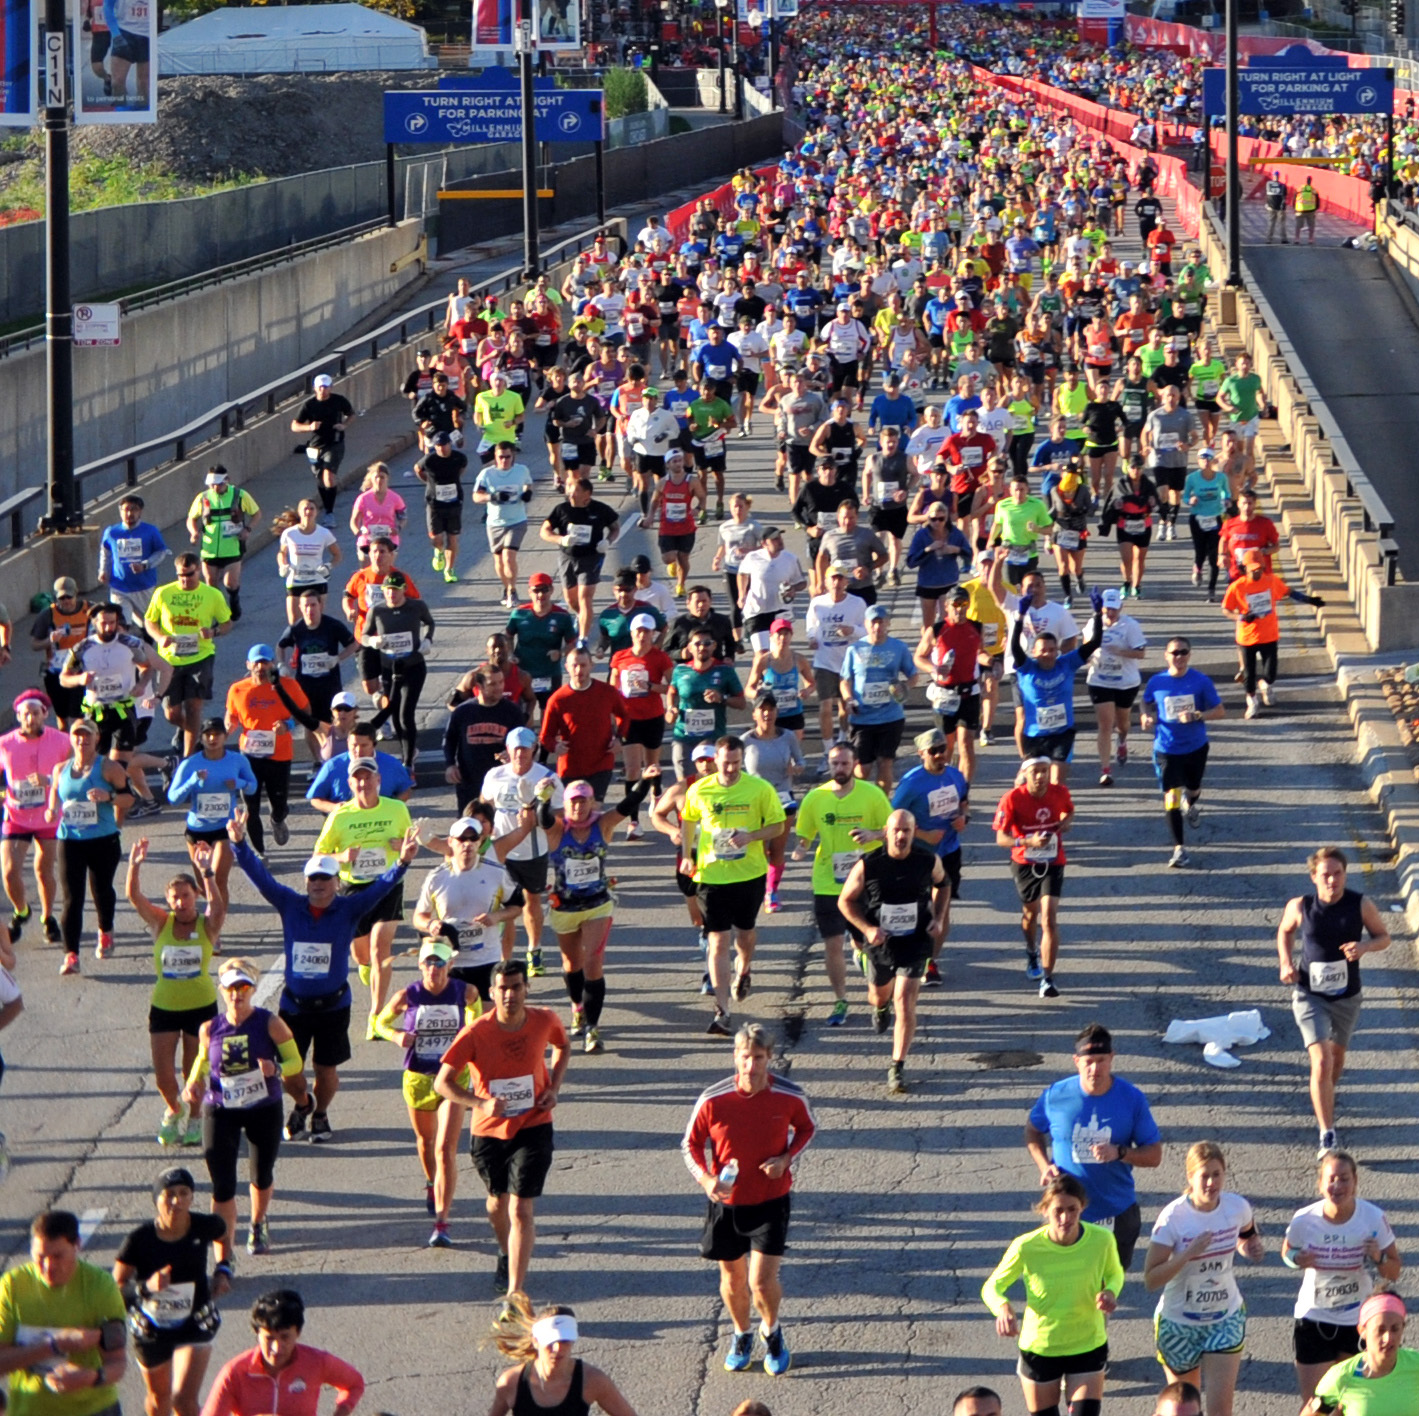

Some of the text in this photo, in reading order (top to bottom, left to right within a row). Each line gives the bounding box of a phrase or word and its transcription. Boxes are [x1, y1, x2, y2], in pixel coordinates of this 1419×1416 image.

[47, 36, 62, 104] C11N
[1239, 72, 1362, 82] TURN RIGHT AT LIGHT
[1251, 83, 1348, 92] FOR PARKING AT
[423, 96, 564, 106] TURN RIGHT AT IGHT
[439, 109, 465, 119] FOR
[535, 108, 548, 118] AT
[1210, 176, 1226, 187] TOP
[426, 1018, 457, 1029] 26133
[1199, 1261, 1223, 1273] SAM
[1196, 1289, 1228, 1303] 20705
